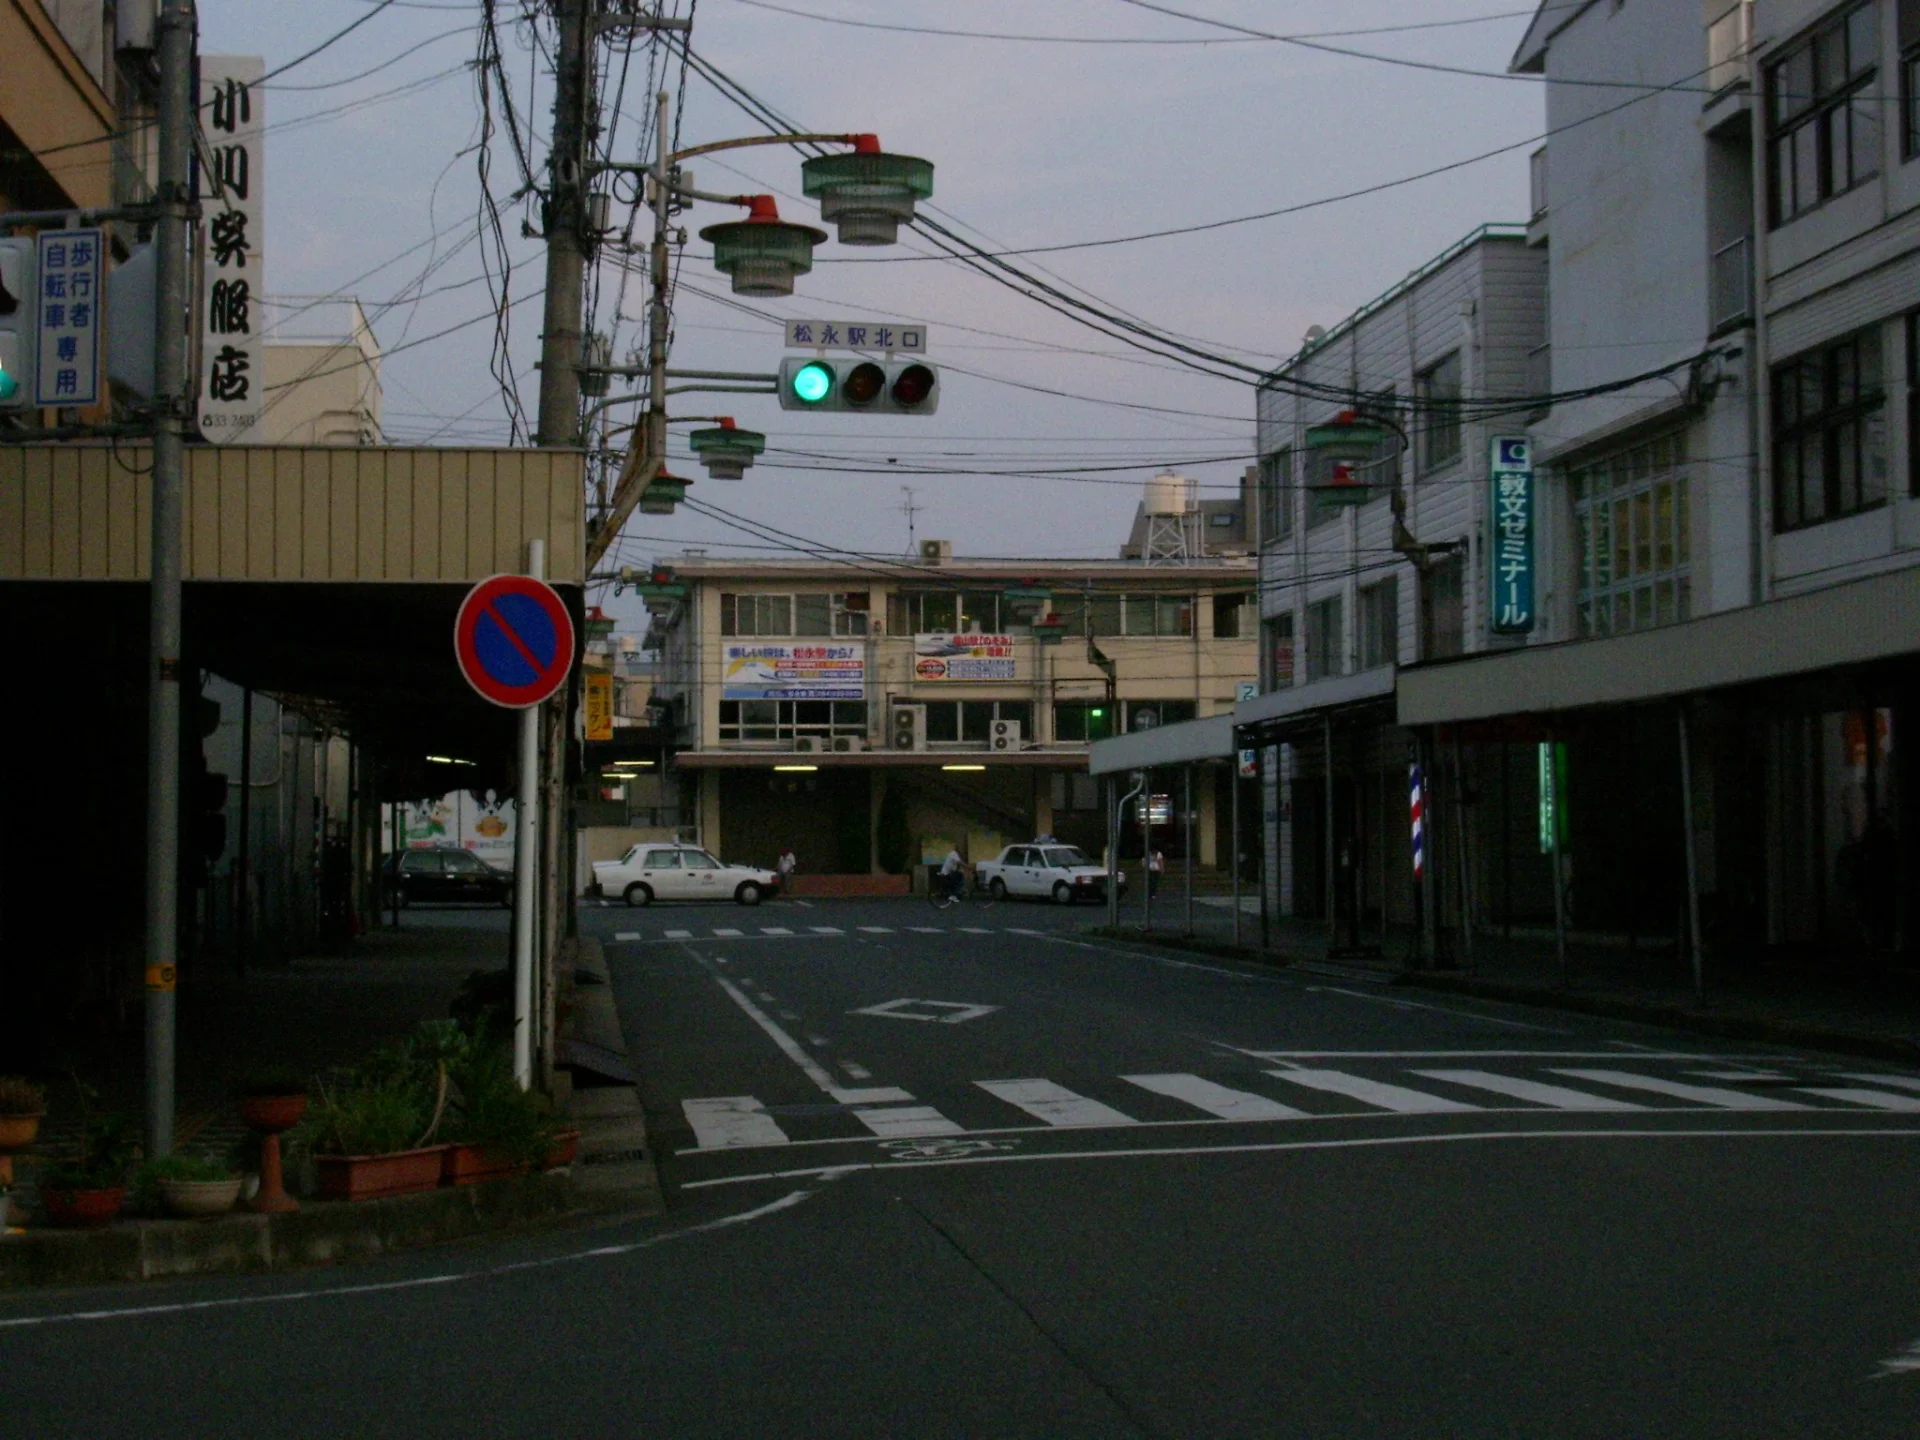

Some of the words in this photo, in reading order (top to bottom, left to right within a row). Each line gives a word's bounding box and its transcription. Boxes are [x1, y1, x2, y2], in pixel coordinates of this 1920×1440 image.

[210, 76, 250, 402] 小川呉服店
[45, 243, 67, 329] 自転車
[70, 240, 92, 328] 歩行者
[56, 335, 78, 395] 専用
[793, 323, 919, 347] 松永駅北口
[1499, 473, 1528, 627] 教文ゼミナール
